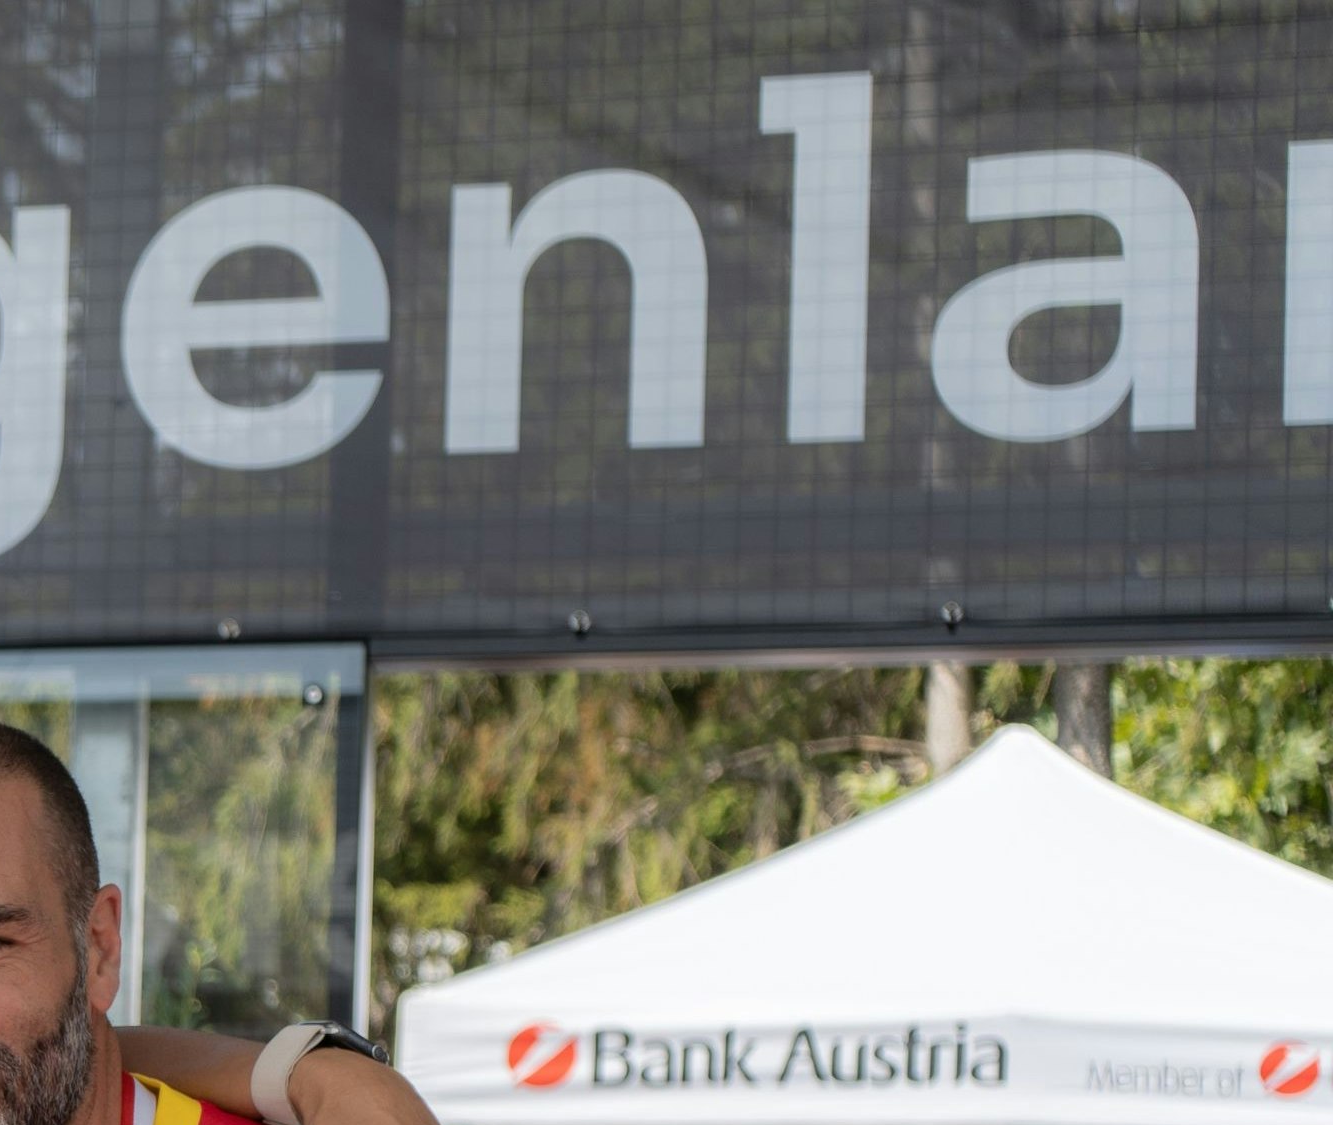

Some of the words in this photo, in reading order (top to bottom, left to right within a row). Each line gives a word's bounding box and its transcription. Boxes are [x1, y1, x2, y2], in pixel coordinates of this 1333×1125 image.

[591, 1027, 760, 1088] Bank
[779, 1021, 1010, 1087] Austria
[1086, 1058, 1205, 1097] Member
